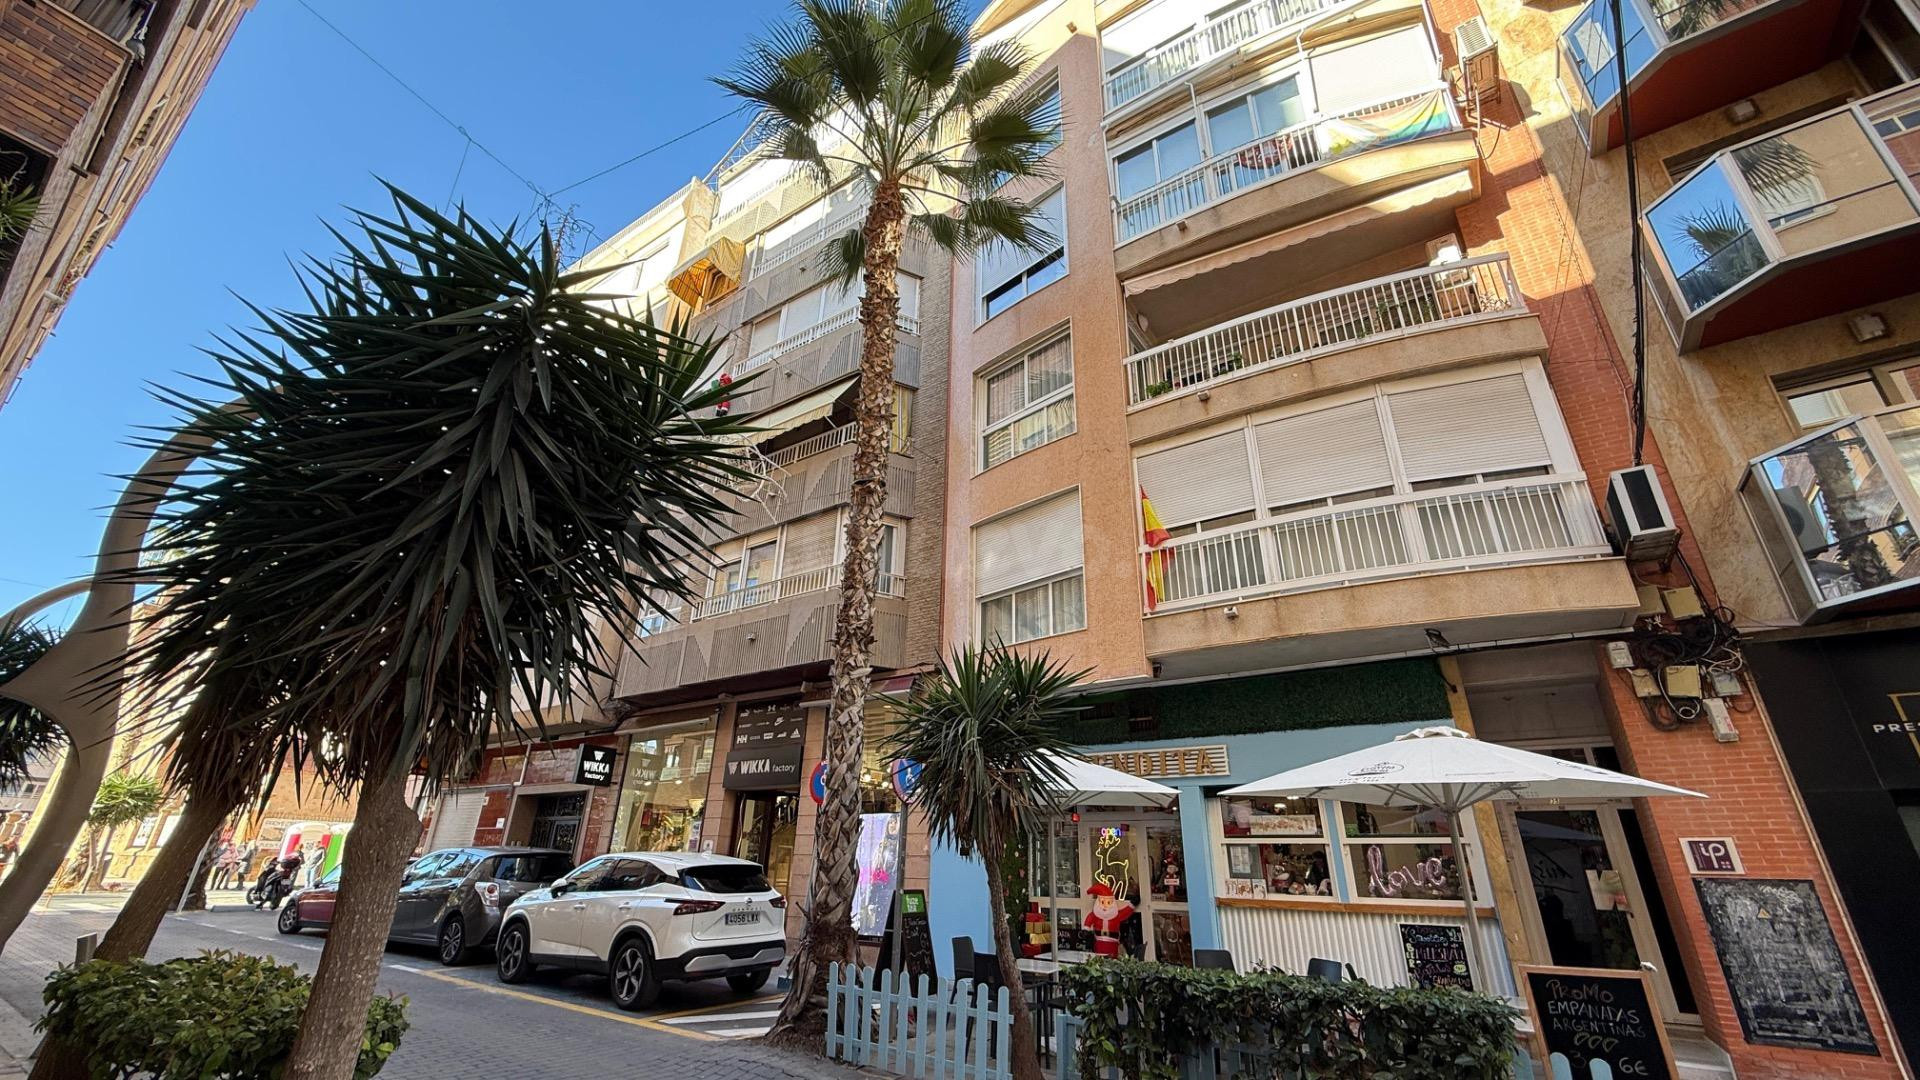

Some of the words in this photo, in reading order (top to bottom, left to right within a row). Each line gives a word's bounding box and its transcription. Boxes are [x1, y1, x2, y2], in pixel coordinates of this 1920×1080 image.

[1872, 722, 1920, 733] PRE
[583, 760, 610, 774] WIKKA
[740, 759, 770, 774] WIKKA
[772, 764, 795, 773] factory
[584, 772, 605, 781] factory
[1367, 845, 1446, 896] love
